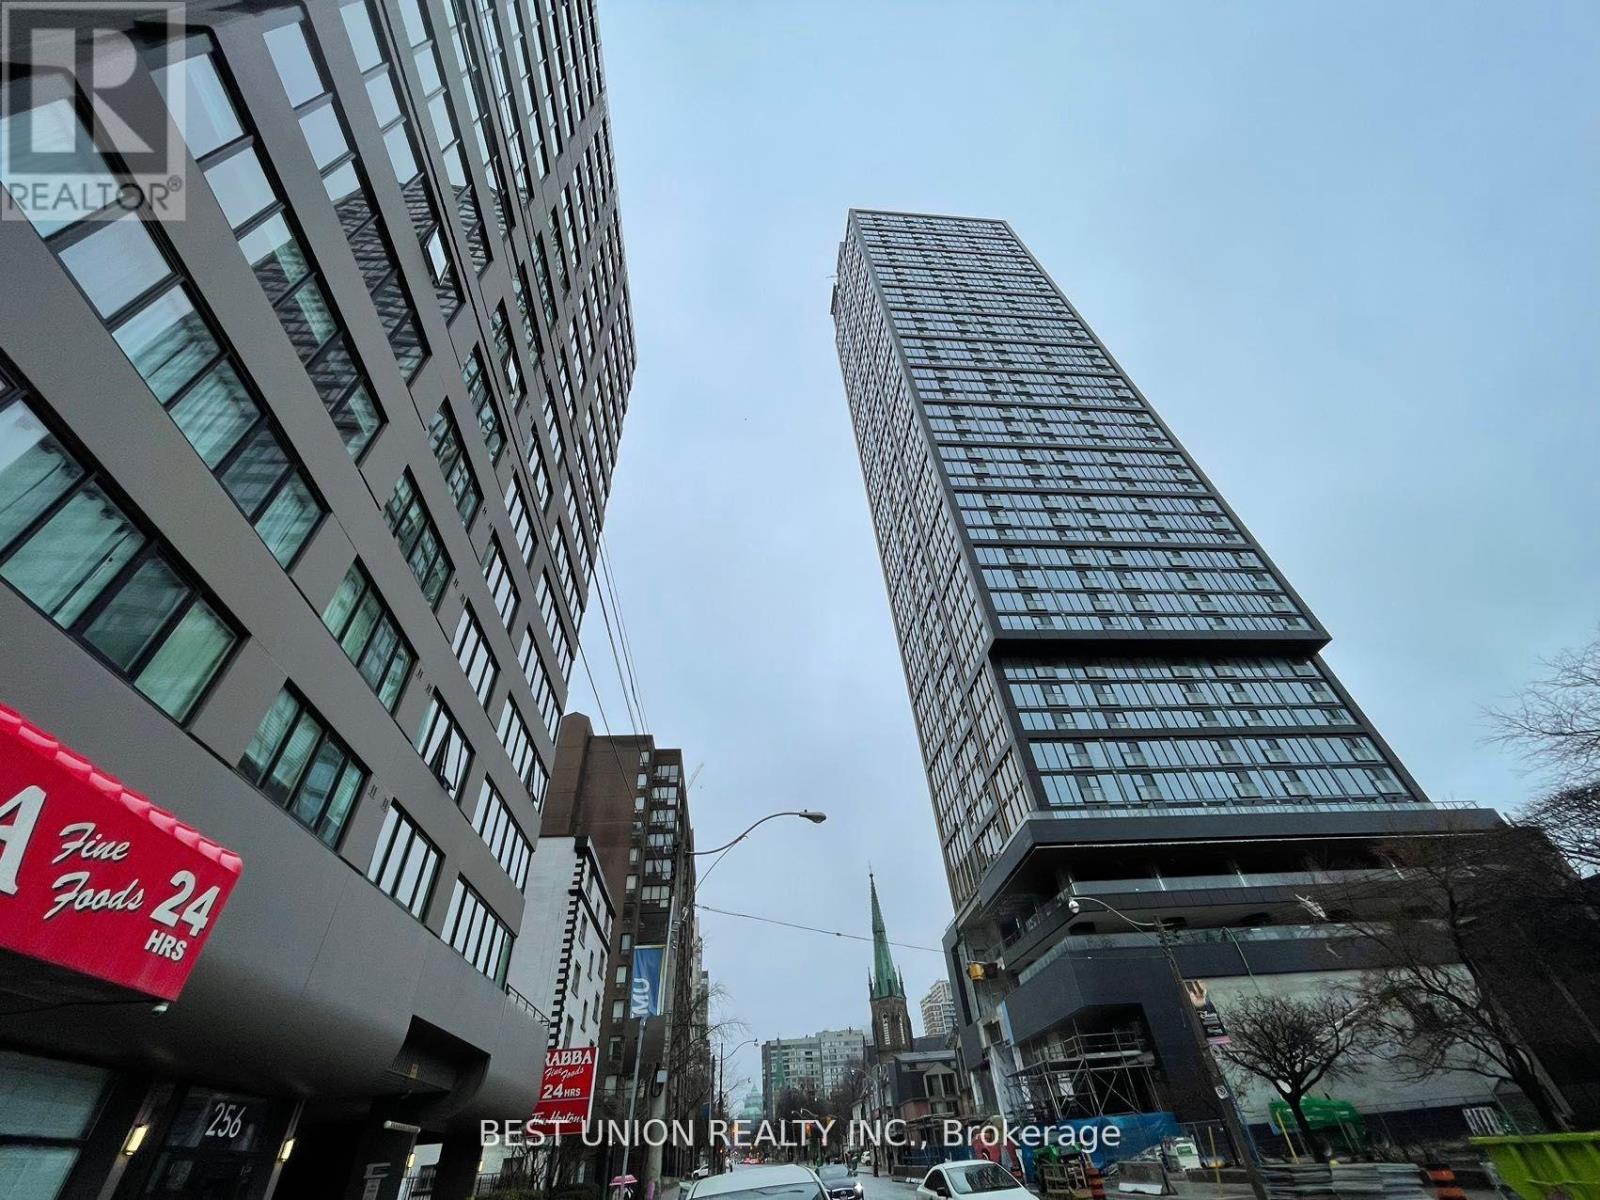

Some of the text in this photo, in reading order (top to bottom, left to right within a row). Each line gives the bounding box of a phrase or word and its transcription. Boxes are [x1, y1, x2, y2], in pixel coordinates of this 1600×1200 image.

[51, 822, 131, 864] Fine
[43, 871, 145, 920] Foods
[149, 870, 221, 937] 24
[144, 929, 188, 961] HRS
[542, 1083, 581, 1099] 24 HRS
[560, 1065, 584, 1082] Foods
[205, 1102, 247, 1138] 256
